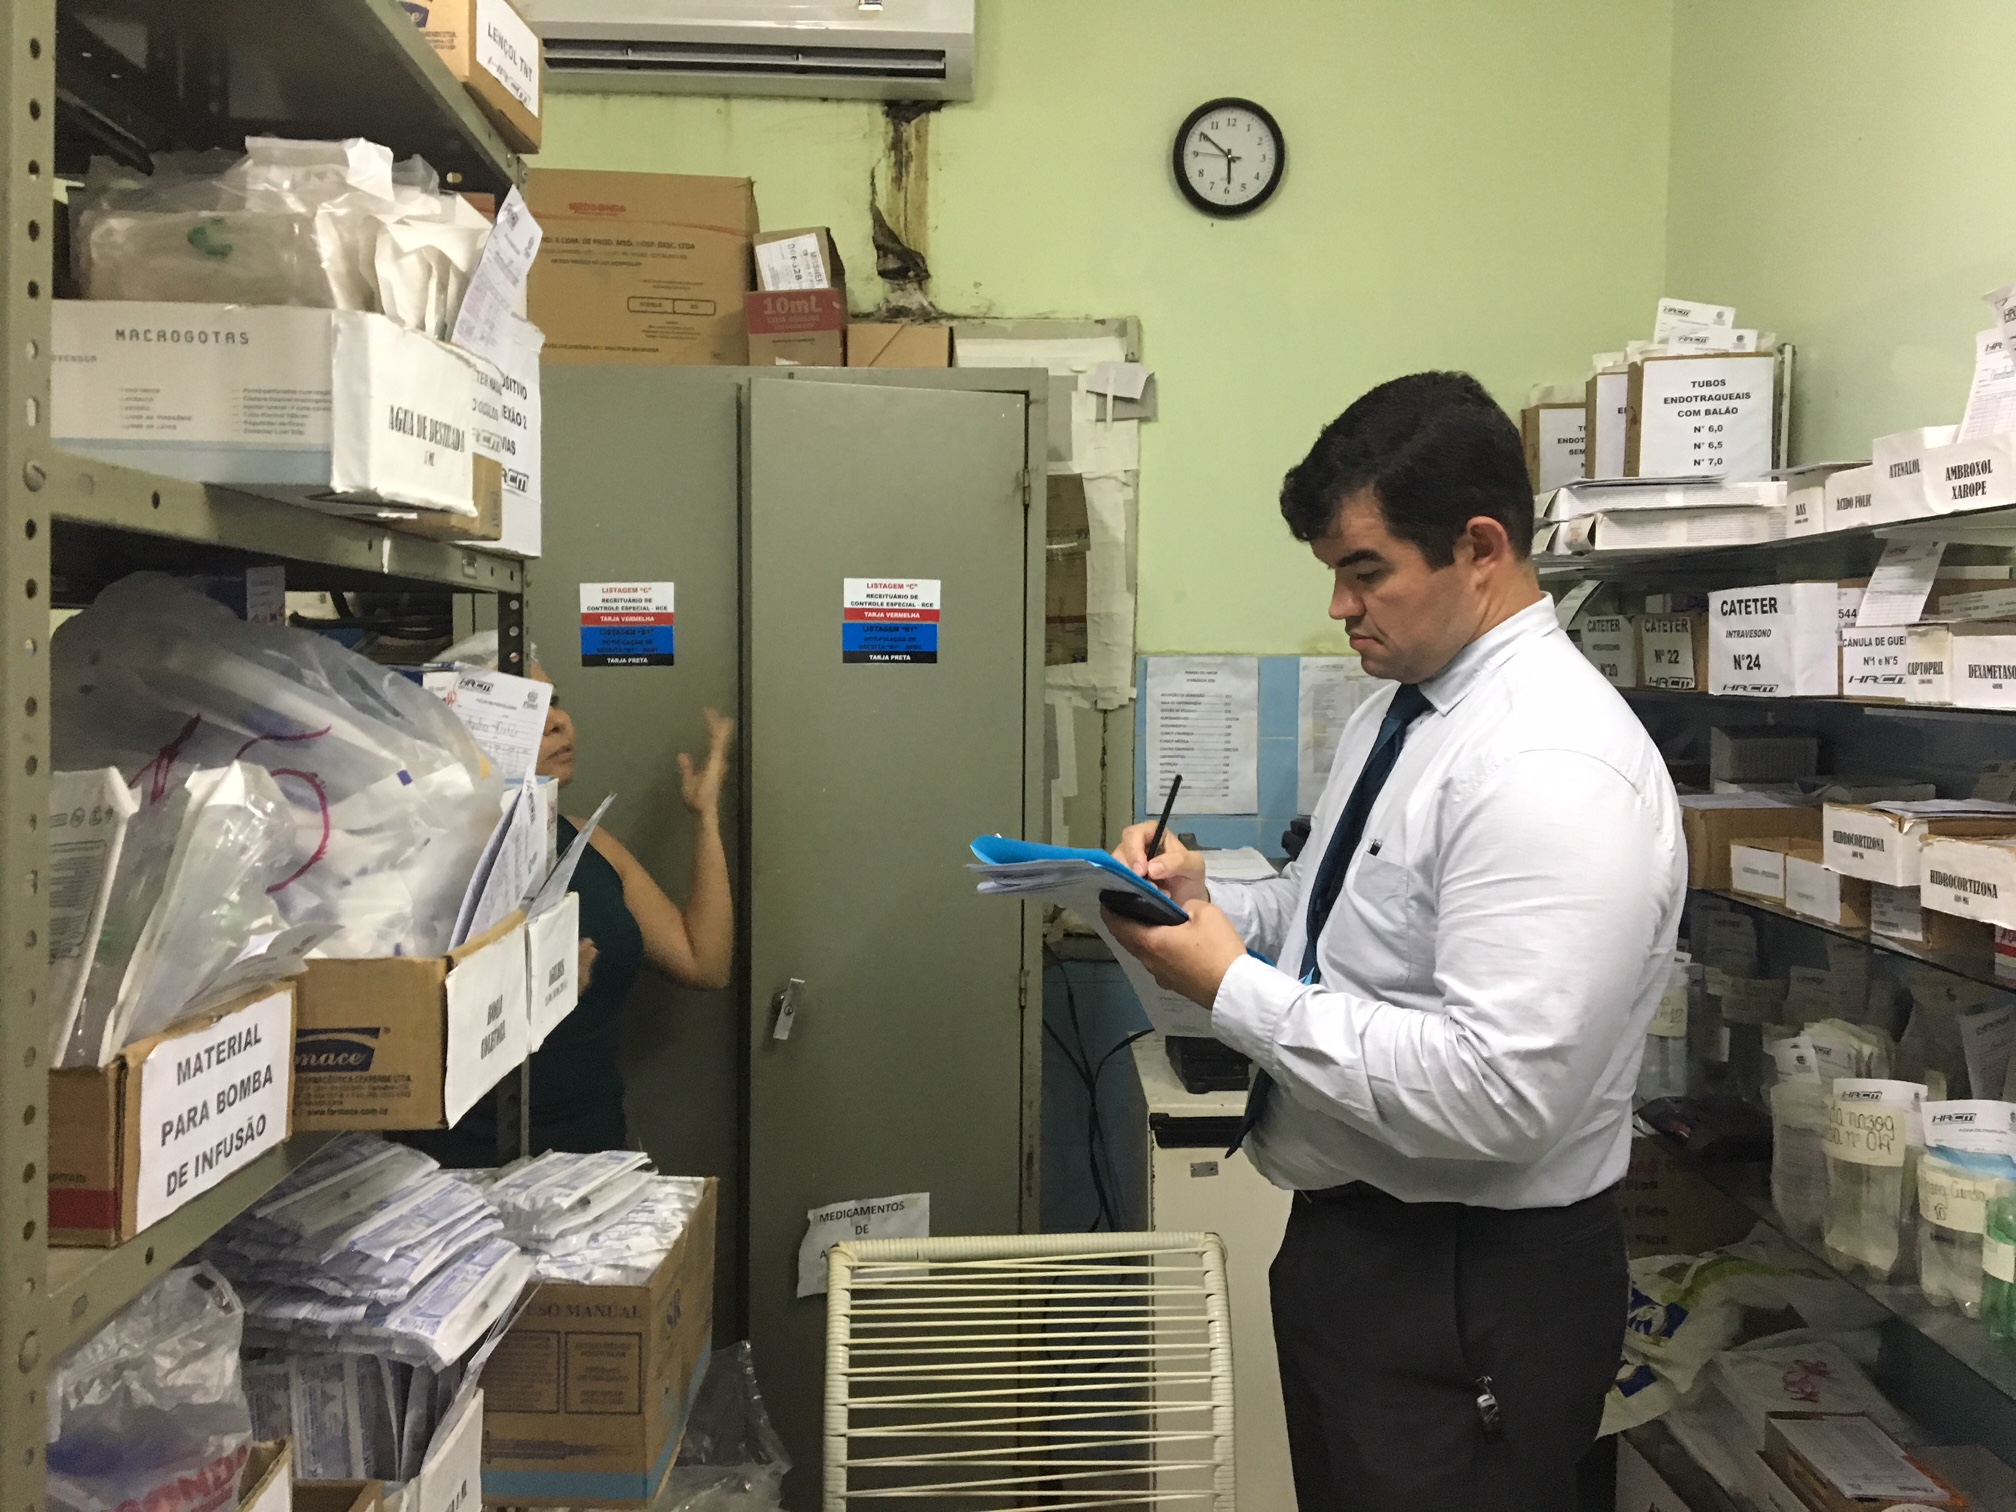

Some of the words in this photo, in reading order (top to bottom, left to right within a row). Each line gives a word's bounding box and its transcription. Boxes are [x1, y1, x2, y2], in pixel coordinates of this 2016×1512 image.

[488, 22, 518, 66] LENÇOL
[519, 57, 533, 81] TNT
[1211, 121, 1219, 130] 11
[1227, 118, 1237, 127] 12
[1246, 124, 1251, 132] 1
[1257, 137, 1263, 146] 2
[1192, 150, 1199, 158] 9
[1260, 154, 1266, 162] 3
[1198, 169, 1204, 178] 8
[1254, 172, 1260, 180] 4
[1209, 181, 1215, 190] 7
[1223, 186, 1230, 194] 6
[1240, 183, 1247, 192] 5
[116, 329, 249, 345] MACROGOTAS
[1691, 379, 1726, 389] TUBOS
[1663, 392, 1751, 404] ENDOTRAQUEAIS
[501, 405, 522, 427] EXÃO
[522, 416, 528, 430] 2
[1677, 410, 1701, 418] COM
[1704, 407, 1739, 416] BALÃO
[416, 414, 428, 440] DE
[1708, 425, 1723, 433] 6,0
[1708, 441, 1723, 450] 6,5
[1708, 458, 1723, 466] 7,0
[1945, 459, 1993, 482] AMBROXOL
[1951, 481, 1987, 500] XAROPE
[1795, 503, 1807, 516] AAS
[1721, 597, 1778, 616] CATETER
[1587, 619, 1621, 632] CATETER
[1644, 619, 1690, 633] CATETER
[1725, 629, 1772, 638] INTRAVESONO
[1875, 637, 1886, 646] DE
[1888, 636, 1906, 646] GUE
[1908, 661, 1944, 675] CAPTOPRIL
[1833, 830, 1885, 852] HIDROCORTIZONA
[1929, 869, 1998, 899] HIDROCORTIZONA
[177, 1024, 262, 1086] MATERIAL
[161, 1100, 210, 1147] PARA
[216, 1064, 273, 1115] BOMBA
[166, 1161, 189, 1197] DE
[194, 1113, 267, 1178] INFUSÃO
[819, 1201, 905, 1223] MEDICAMENTOS
[855, 1224, 869, 1235] DE
[566, 1304, 642, 1319] MANUAL
